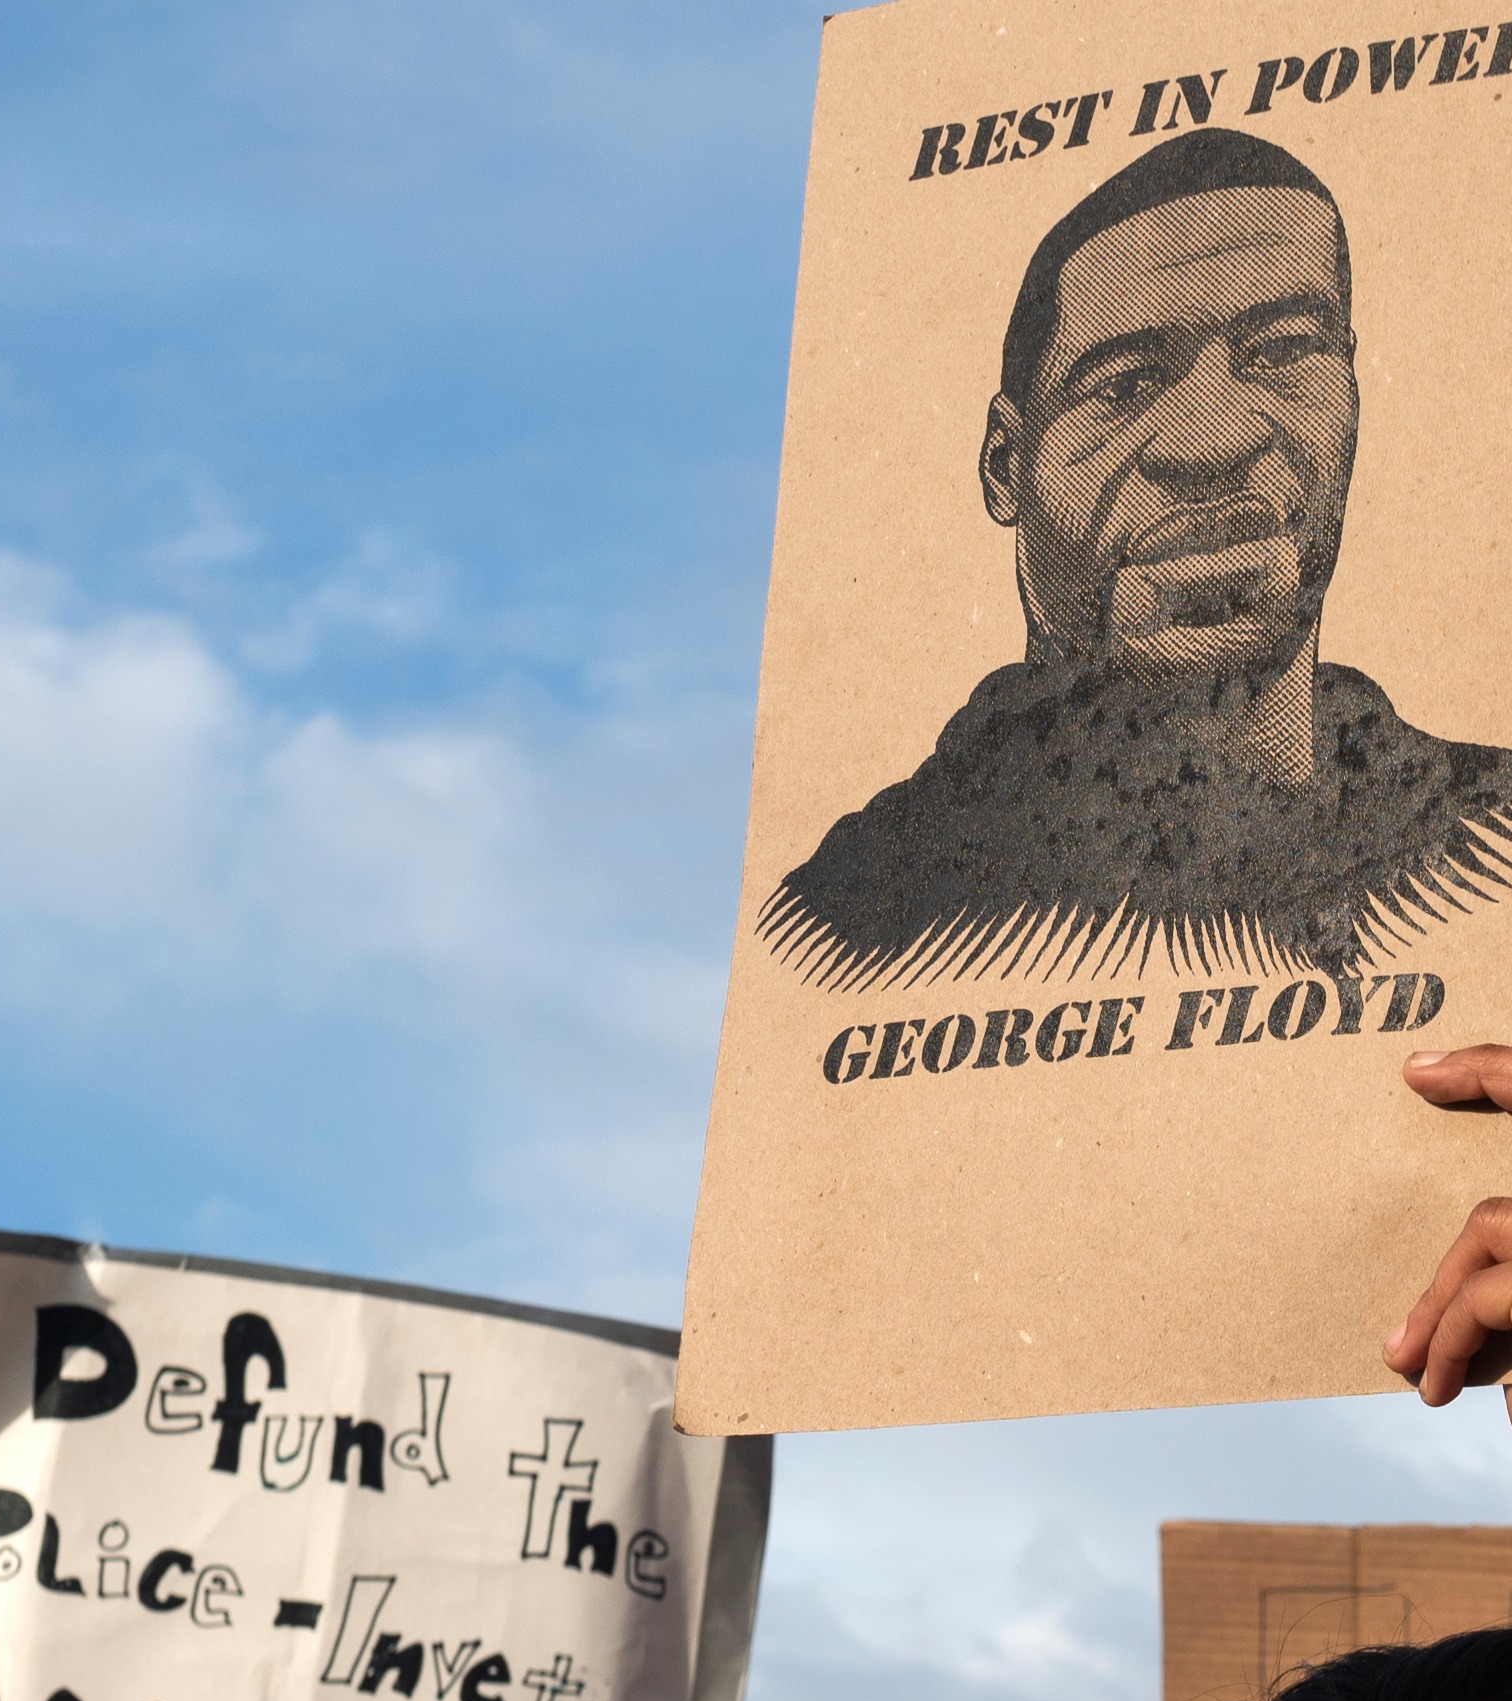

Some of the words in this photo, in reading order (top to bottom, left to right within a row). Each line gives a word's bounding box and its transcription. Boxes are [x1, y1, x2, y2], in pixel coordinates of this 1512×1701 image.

[908, 91, 1113, 182] REST
[1128, 70, 1226, 136] IN
[822, 995, 1145, 1086] GEORGE
[1164, 971, 1446, 1050] FLOYD
[33, 1304, 452, 1492] Defund
